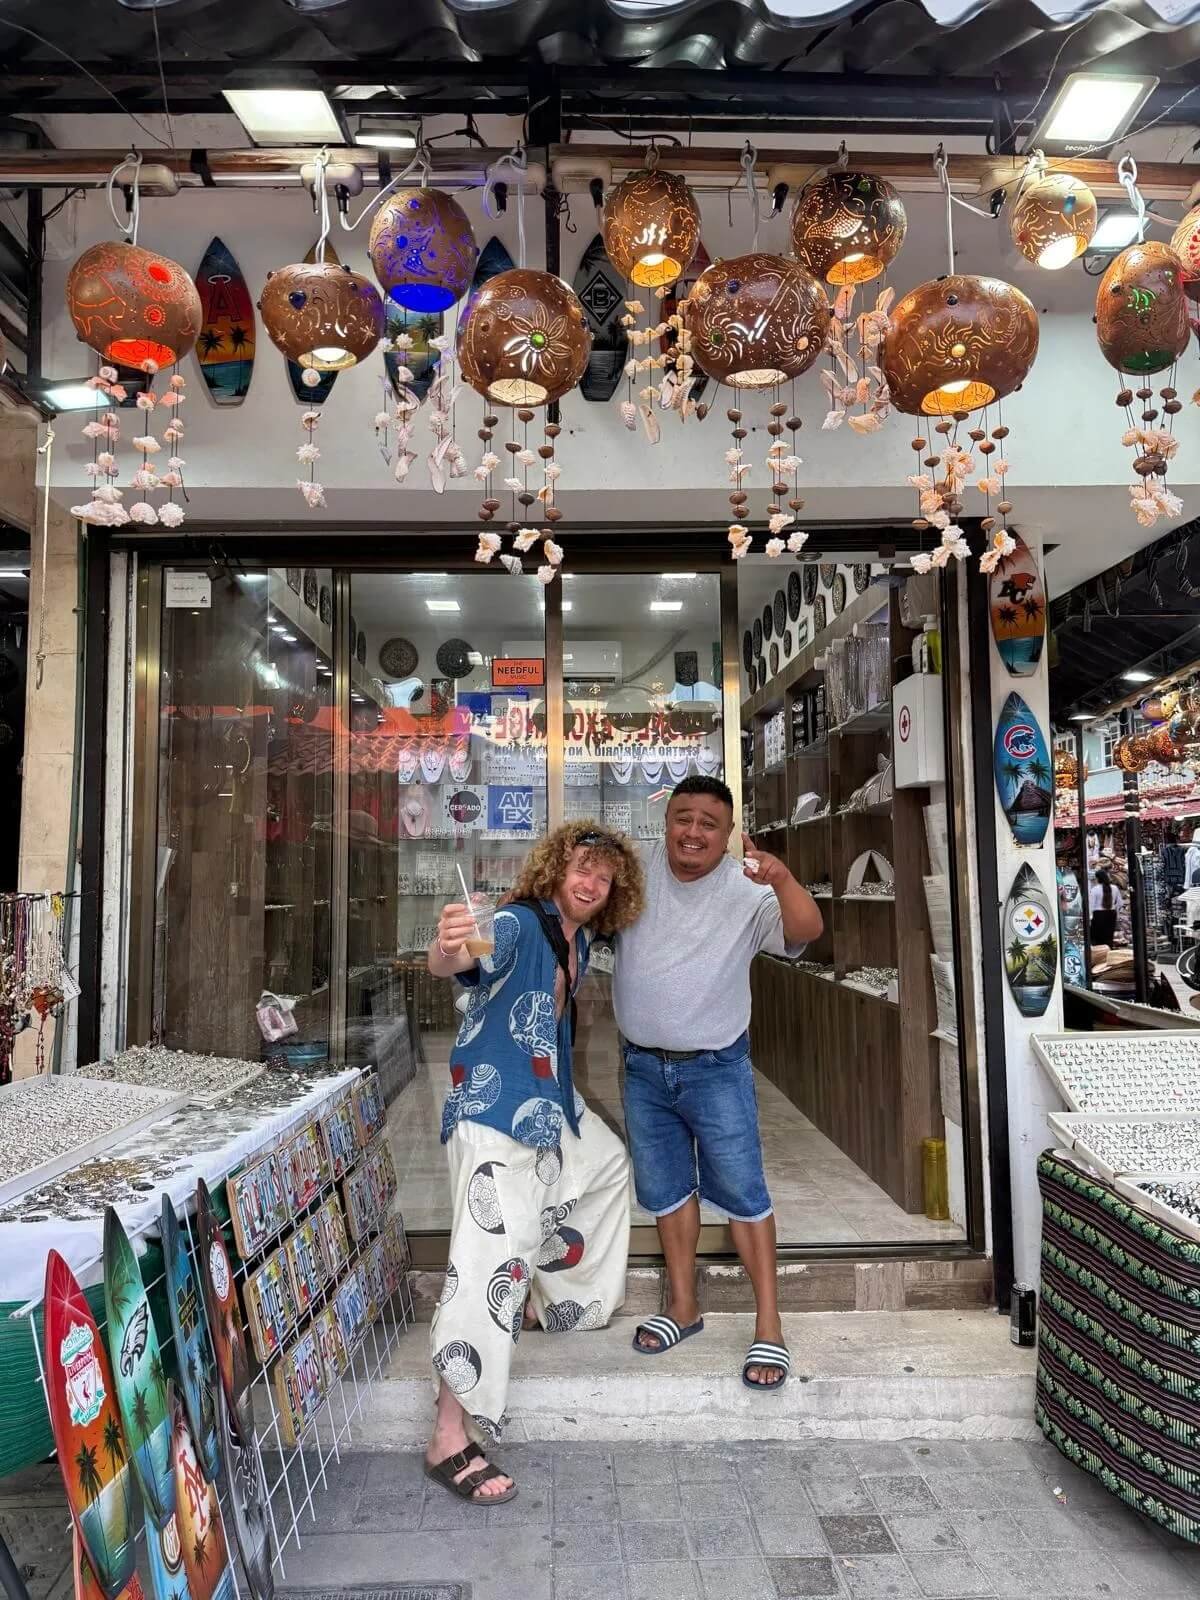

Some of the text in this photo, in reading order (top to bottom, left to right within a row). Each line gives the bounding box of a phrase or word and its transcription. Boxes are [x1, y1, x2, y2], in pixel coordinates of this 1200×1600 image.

[497, 666, 540, 674] NEEDFUL
[460, 712, 489, 725] VISA
[285, 1346, 320, 1414] BRONCOS
